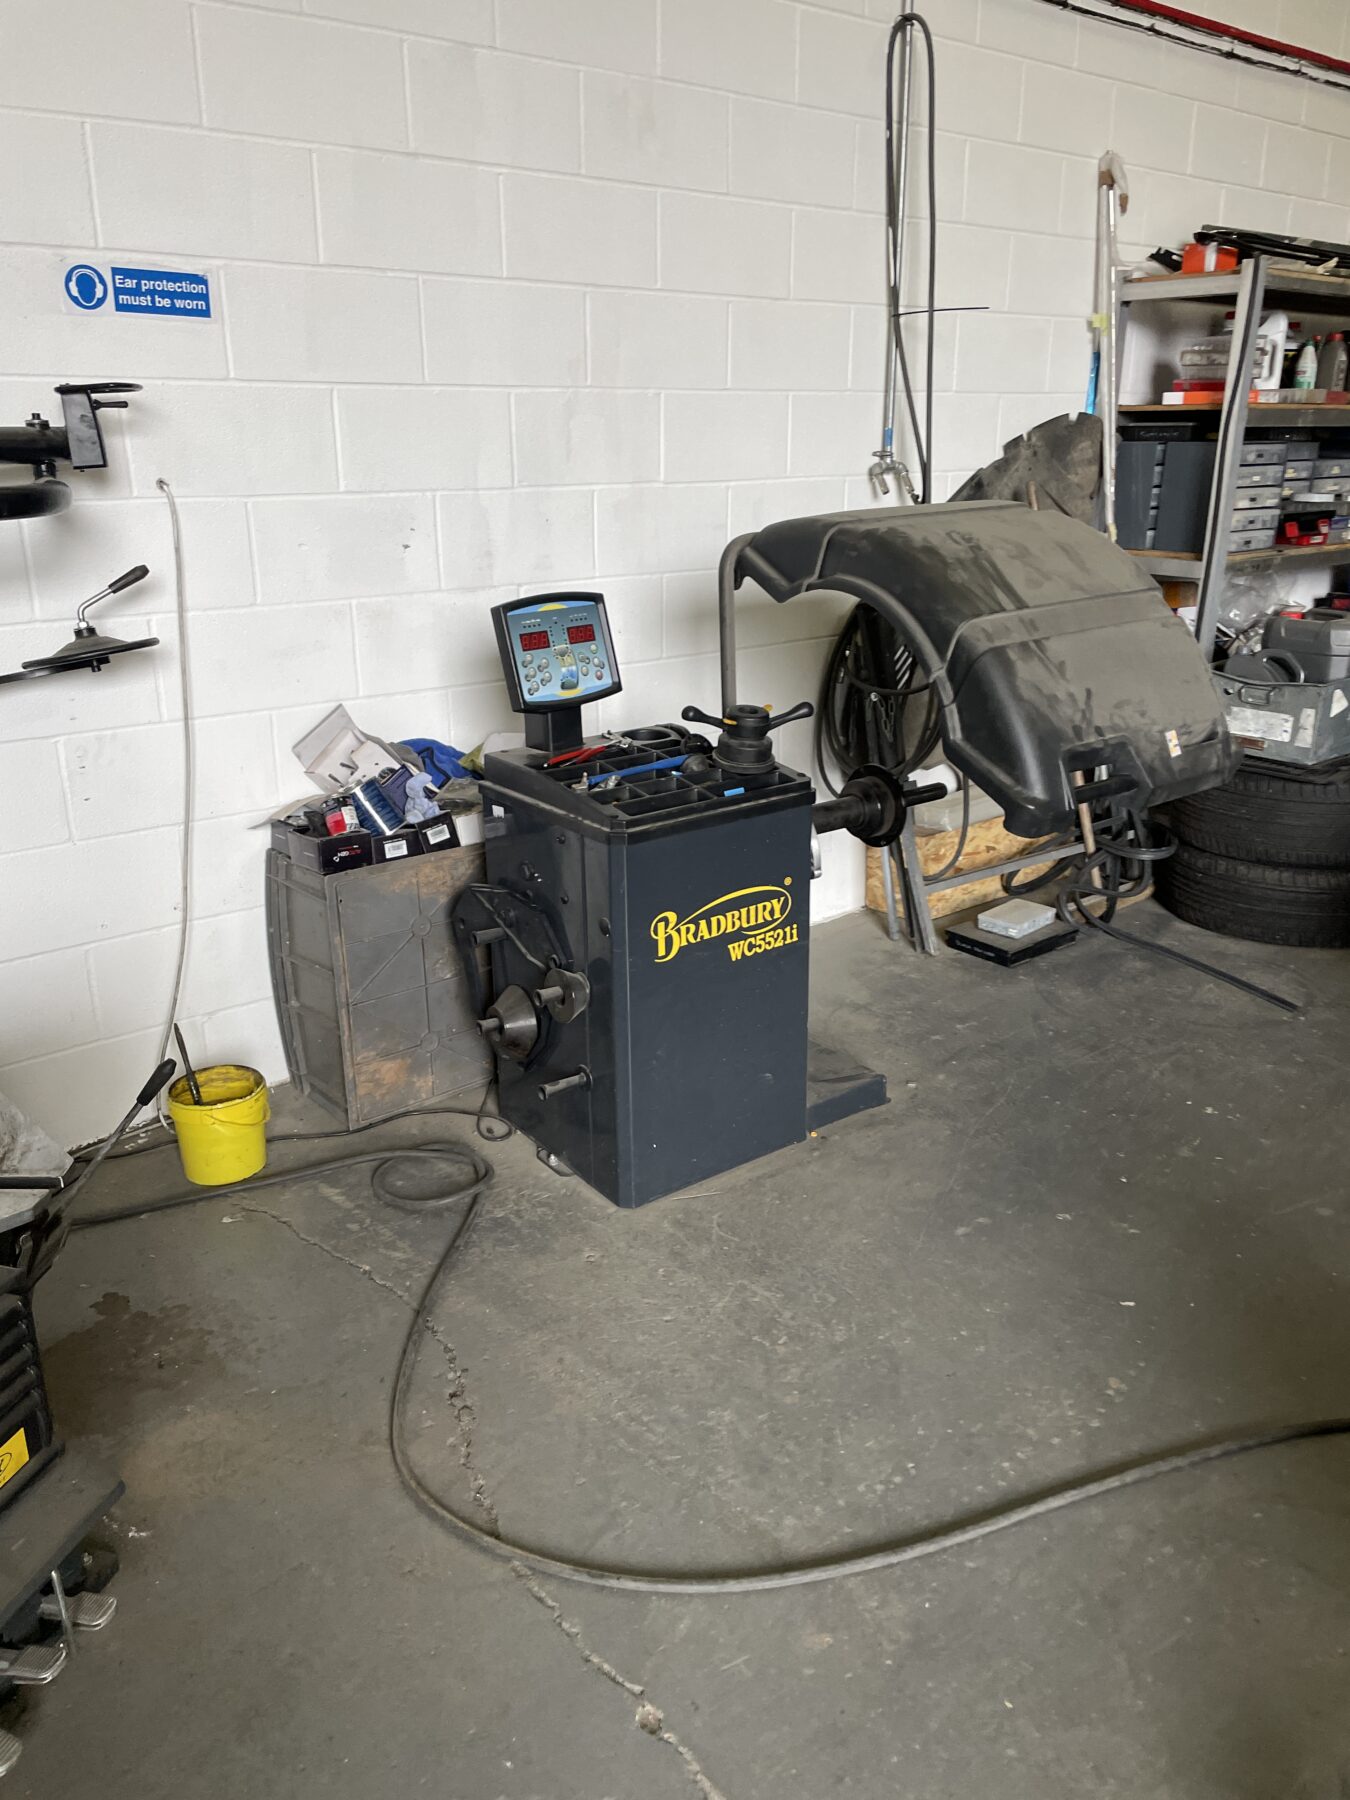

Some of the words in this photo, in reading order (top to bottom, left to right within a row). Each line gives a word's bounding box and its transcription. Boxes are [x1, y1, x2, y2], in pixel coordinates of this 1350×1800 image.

[114, 275, 137, 289] Ear
[141, 279, 207, 294] protection
[118, 294, 151, 306] must
[155, 295, 171, 308] be
[174, 299, 206, 310] worn
[650, 896, 786, 963] BRADBURY
[727, 923, 799, 962] WC5521i
